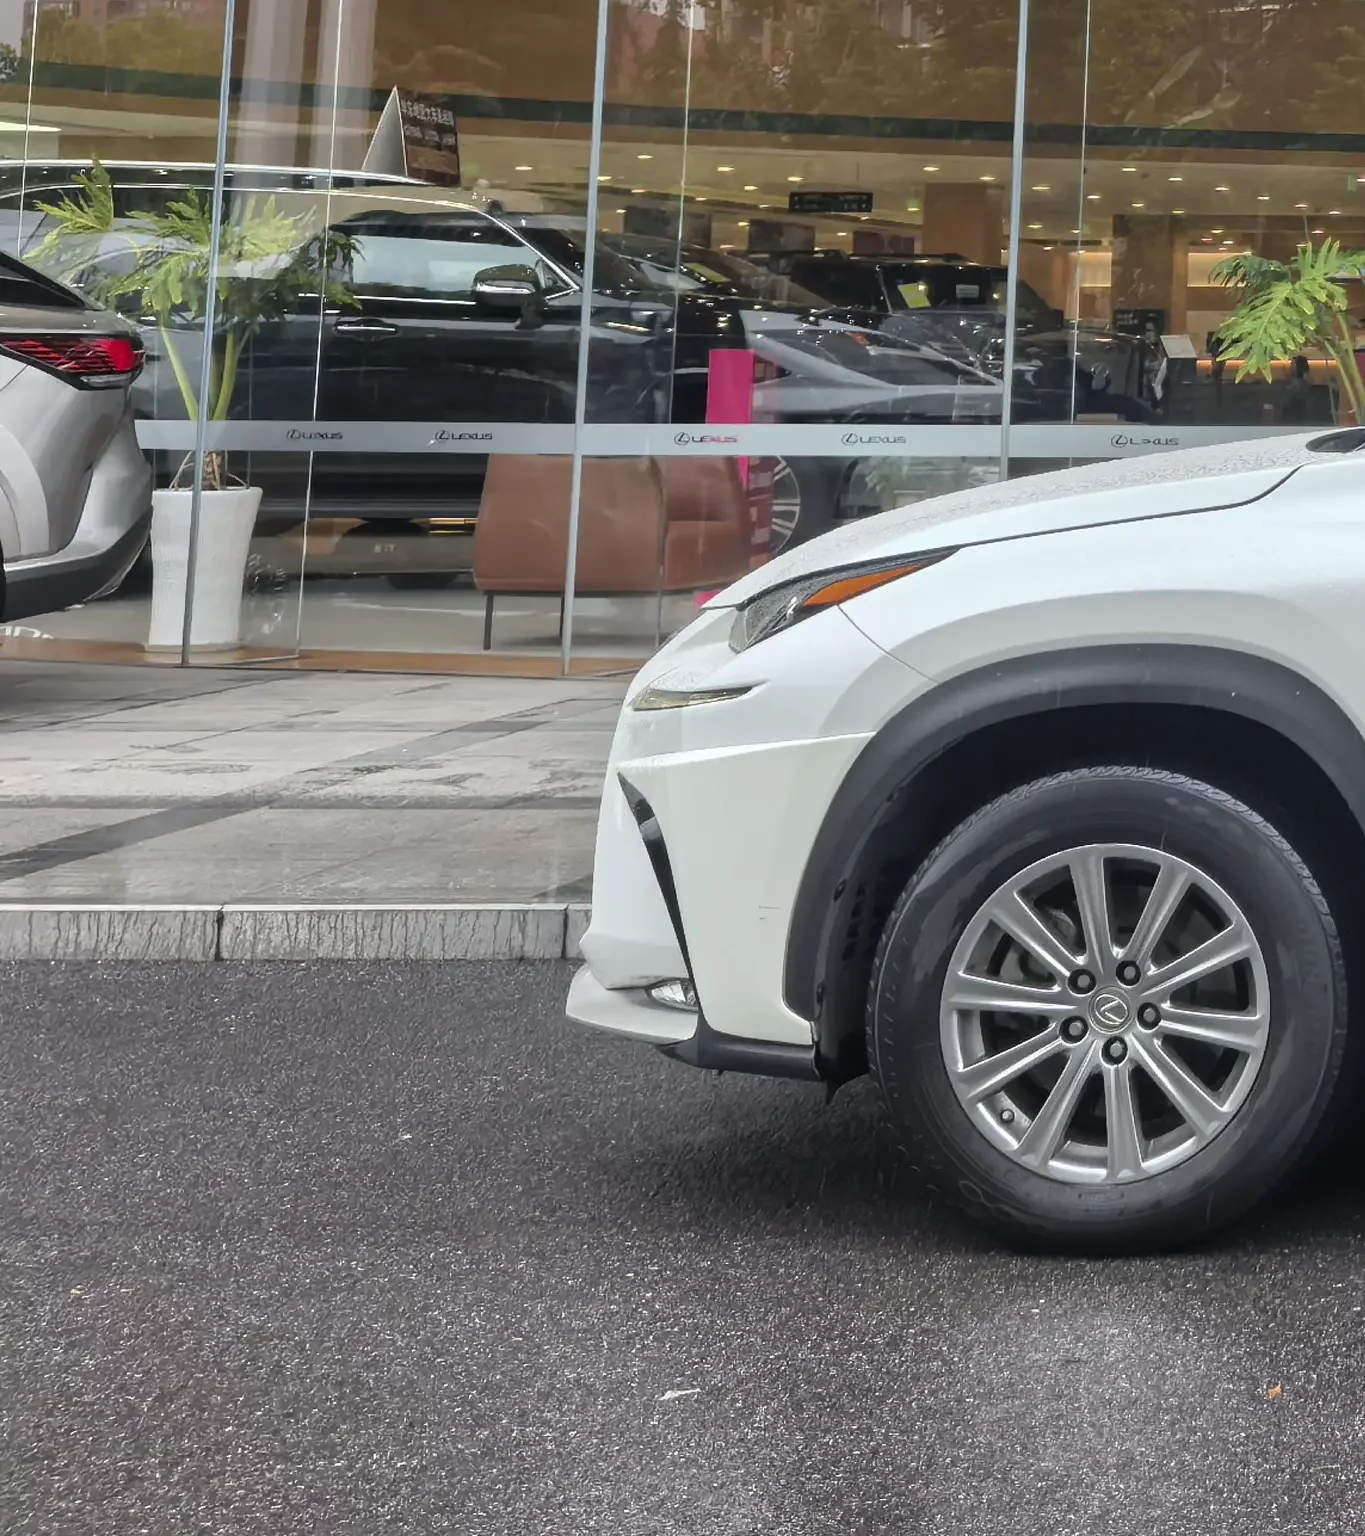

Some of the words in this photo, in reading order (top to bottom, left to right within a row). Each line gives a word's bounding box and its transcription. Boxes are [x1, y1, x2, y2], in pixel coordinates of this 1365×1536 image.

[301, 431, 344, 441] LEXUS
[450, 432, 493, 441] LEXUS
[691, 434, 739, 444] LEXUS
[859, 435, 907, 445] LEXUS
